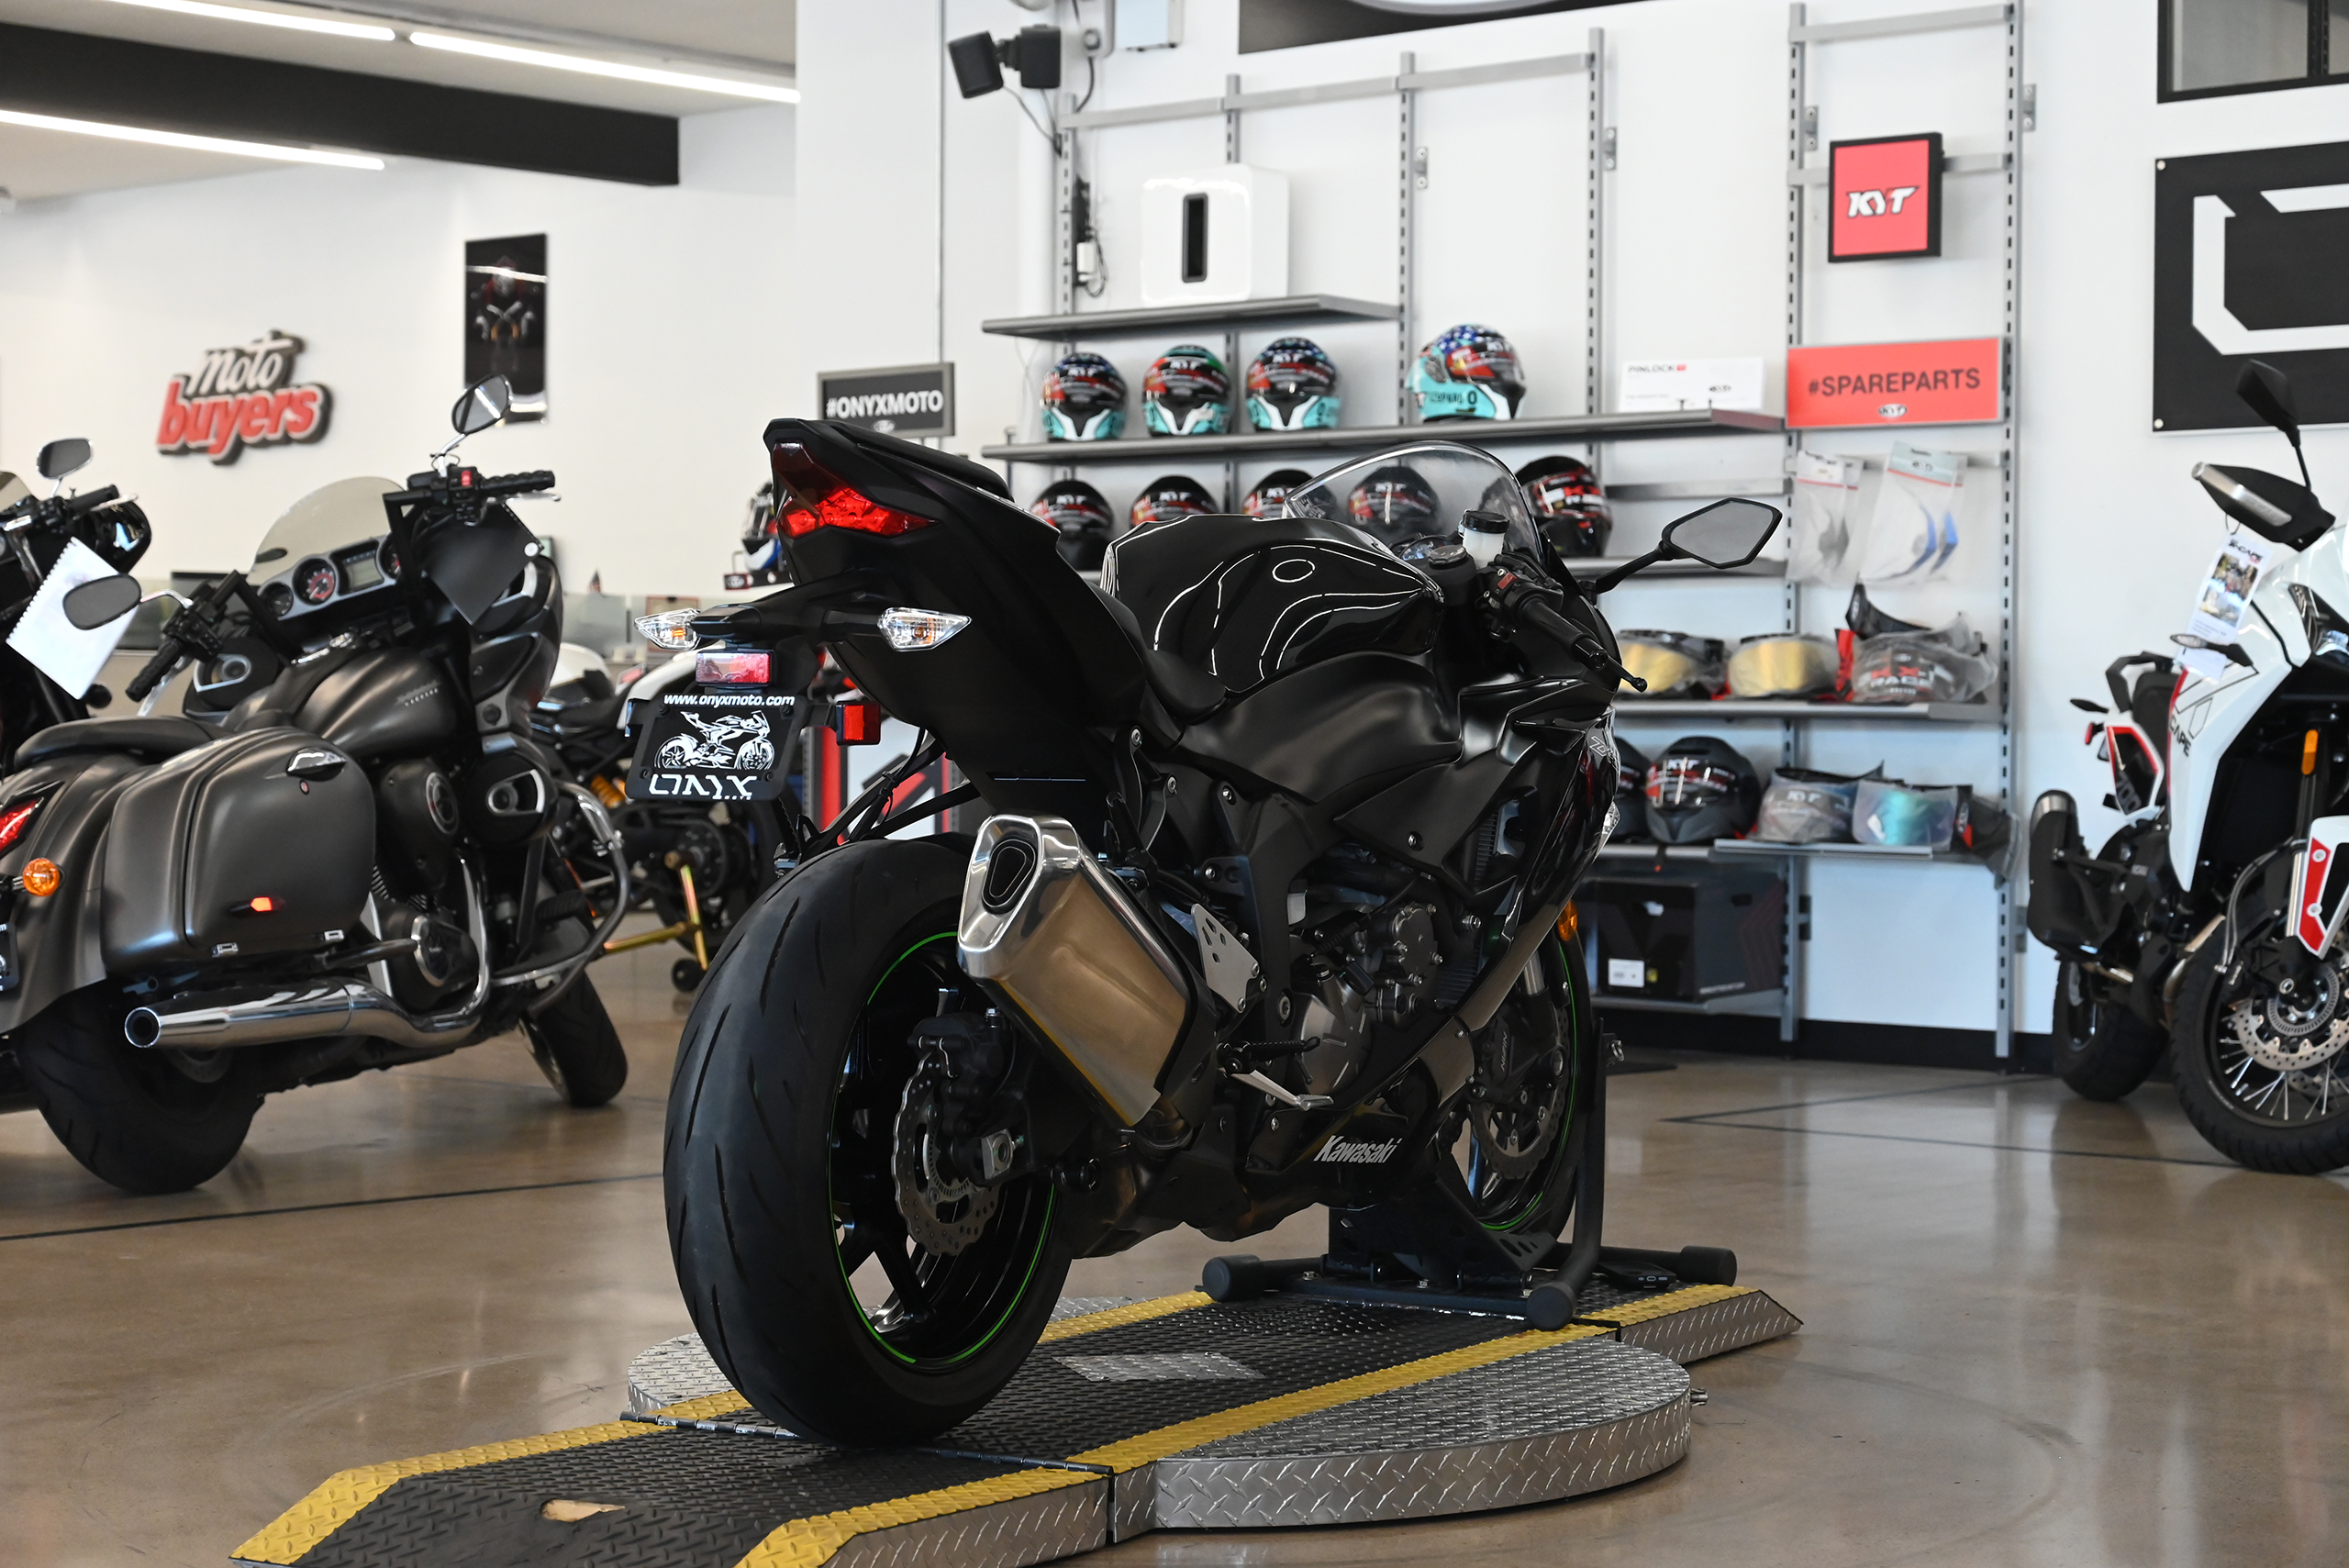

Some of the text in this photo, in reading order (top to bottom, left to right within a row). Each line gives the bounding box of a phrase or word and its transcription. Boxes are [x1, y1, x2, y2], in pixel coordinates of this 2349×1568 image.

[1846, 185, 1920, 217] KYT
[1809, 367, 1981, 397] #SPAREPARTS
[157, 379, 320, 457] buyers
[826, 389, 944, 419] #ONYXMOTO
[664, 695, 796, 708] www.onyxmoto.com
[649, 773, 758, 800] ONYX
[1313, 1135, 1403, 1163] Kawasaki
